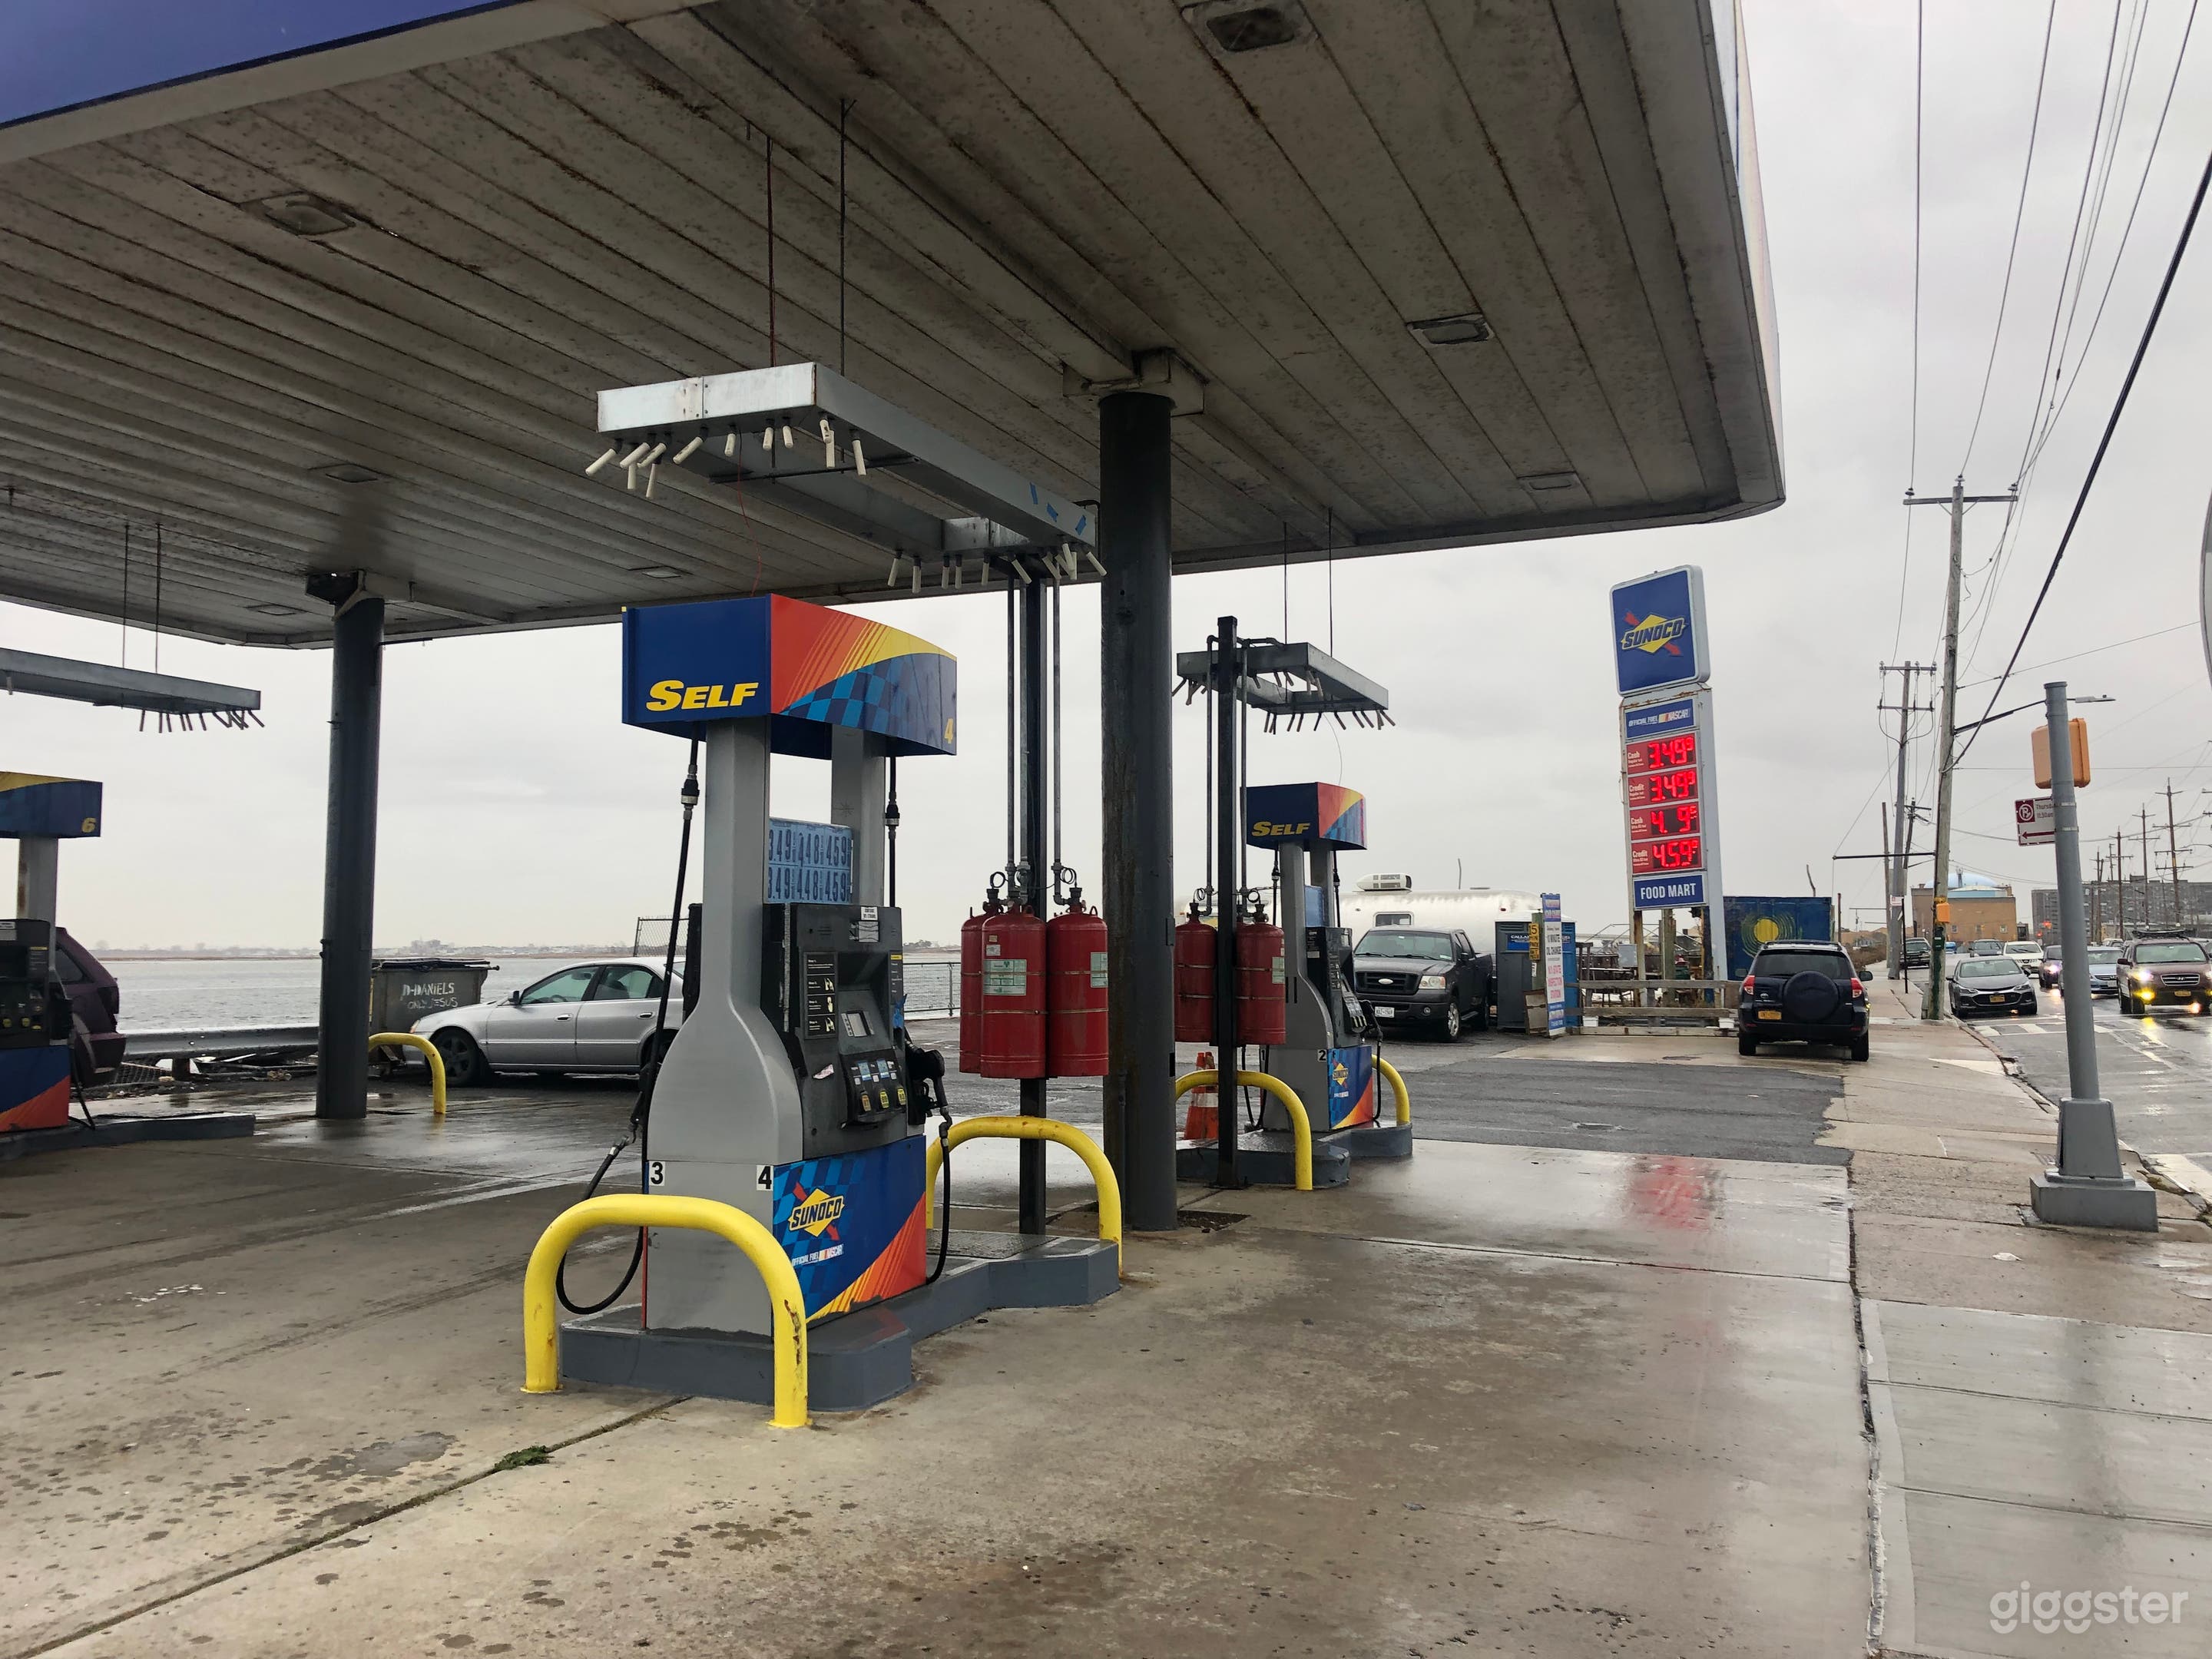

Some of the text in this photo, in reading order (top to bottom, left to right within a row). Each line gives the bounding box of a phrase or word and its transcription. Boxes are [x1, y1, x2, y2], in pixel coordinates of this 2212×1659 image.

[1623, 619, 1683, 647] SUNOCO
[646, 680, 760, 711] SELF
[944, 717, 954, 744] 4
[81, 817, 96, 833] 6
[1251, 821, 1310, 836] SELF
[1640, 882, 1697, 900] FOOD MART
[427, 997, 459, 1009] JESUS
[1319, 1049, 1326, 1061] 2
[651, 1161, 664, 1185] 3
[758, 1166, 772, 1190] 4
[791, 1198, 842, 1228] SUNOCO
[810, 1251, 819, 1262] FUEL
